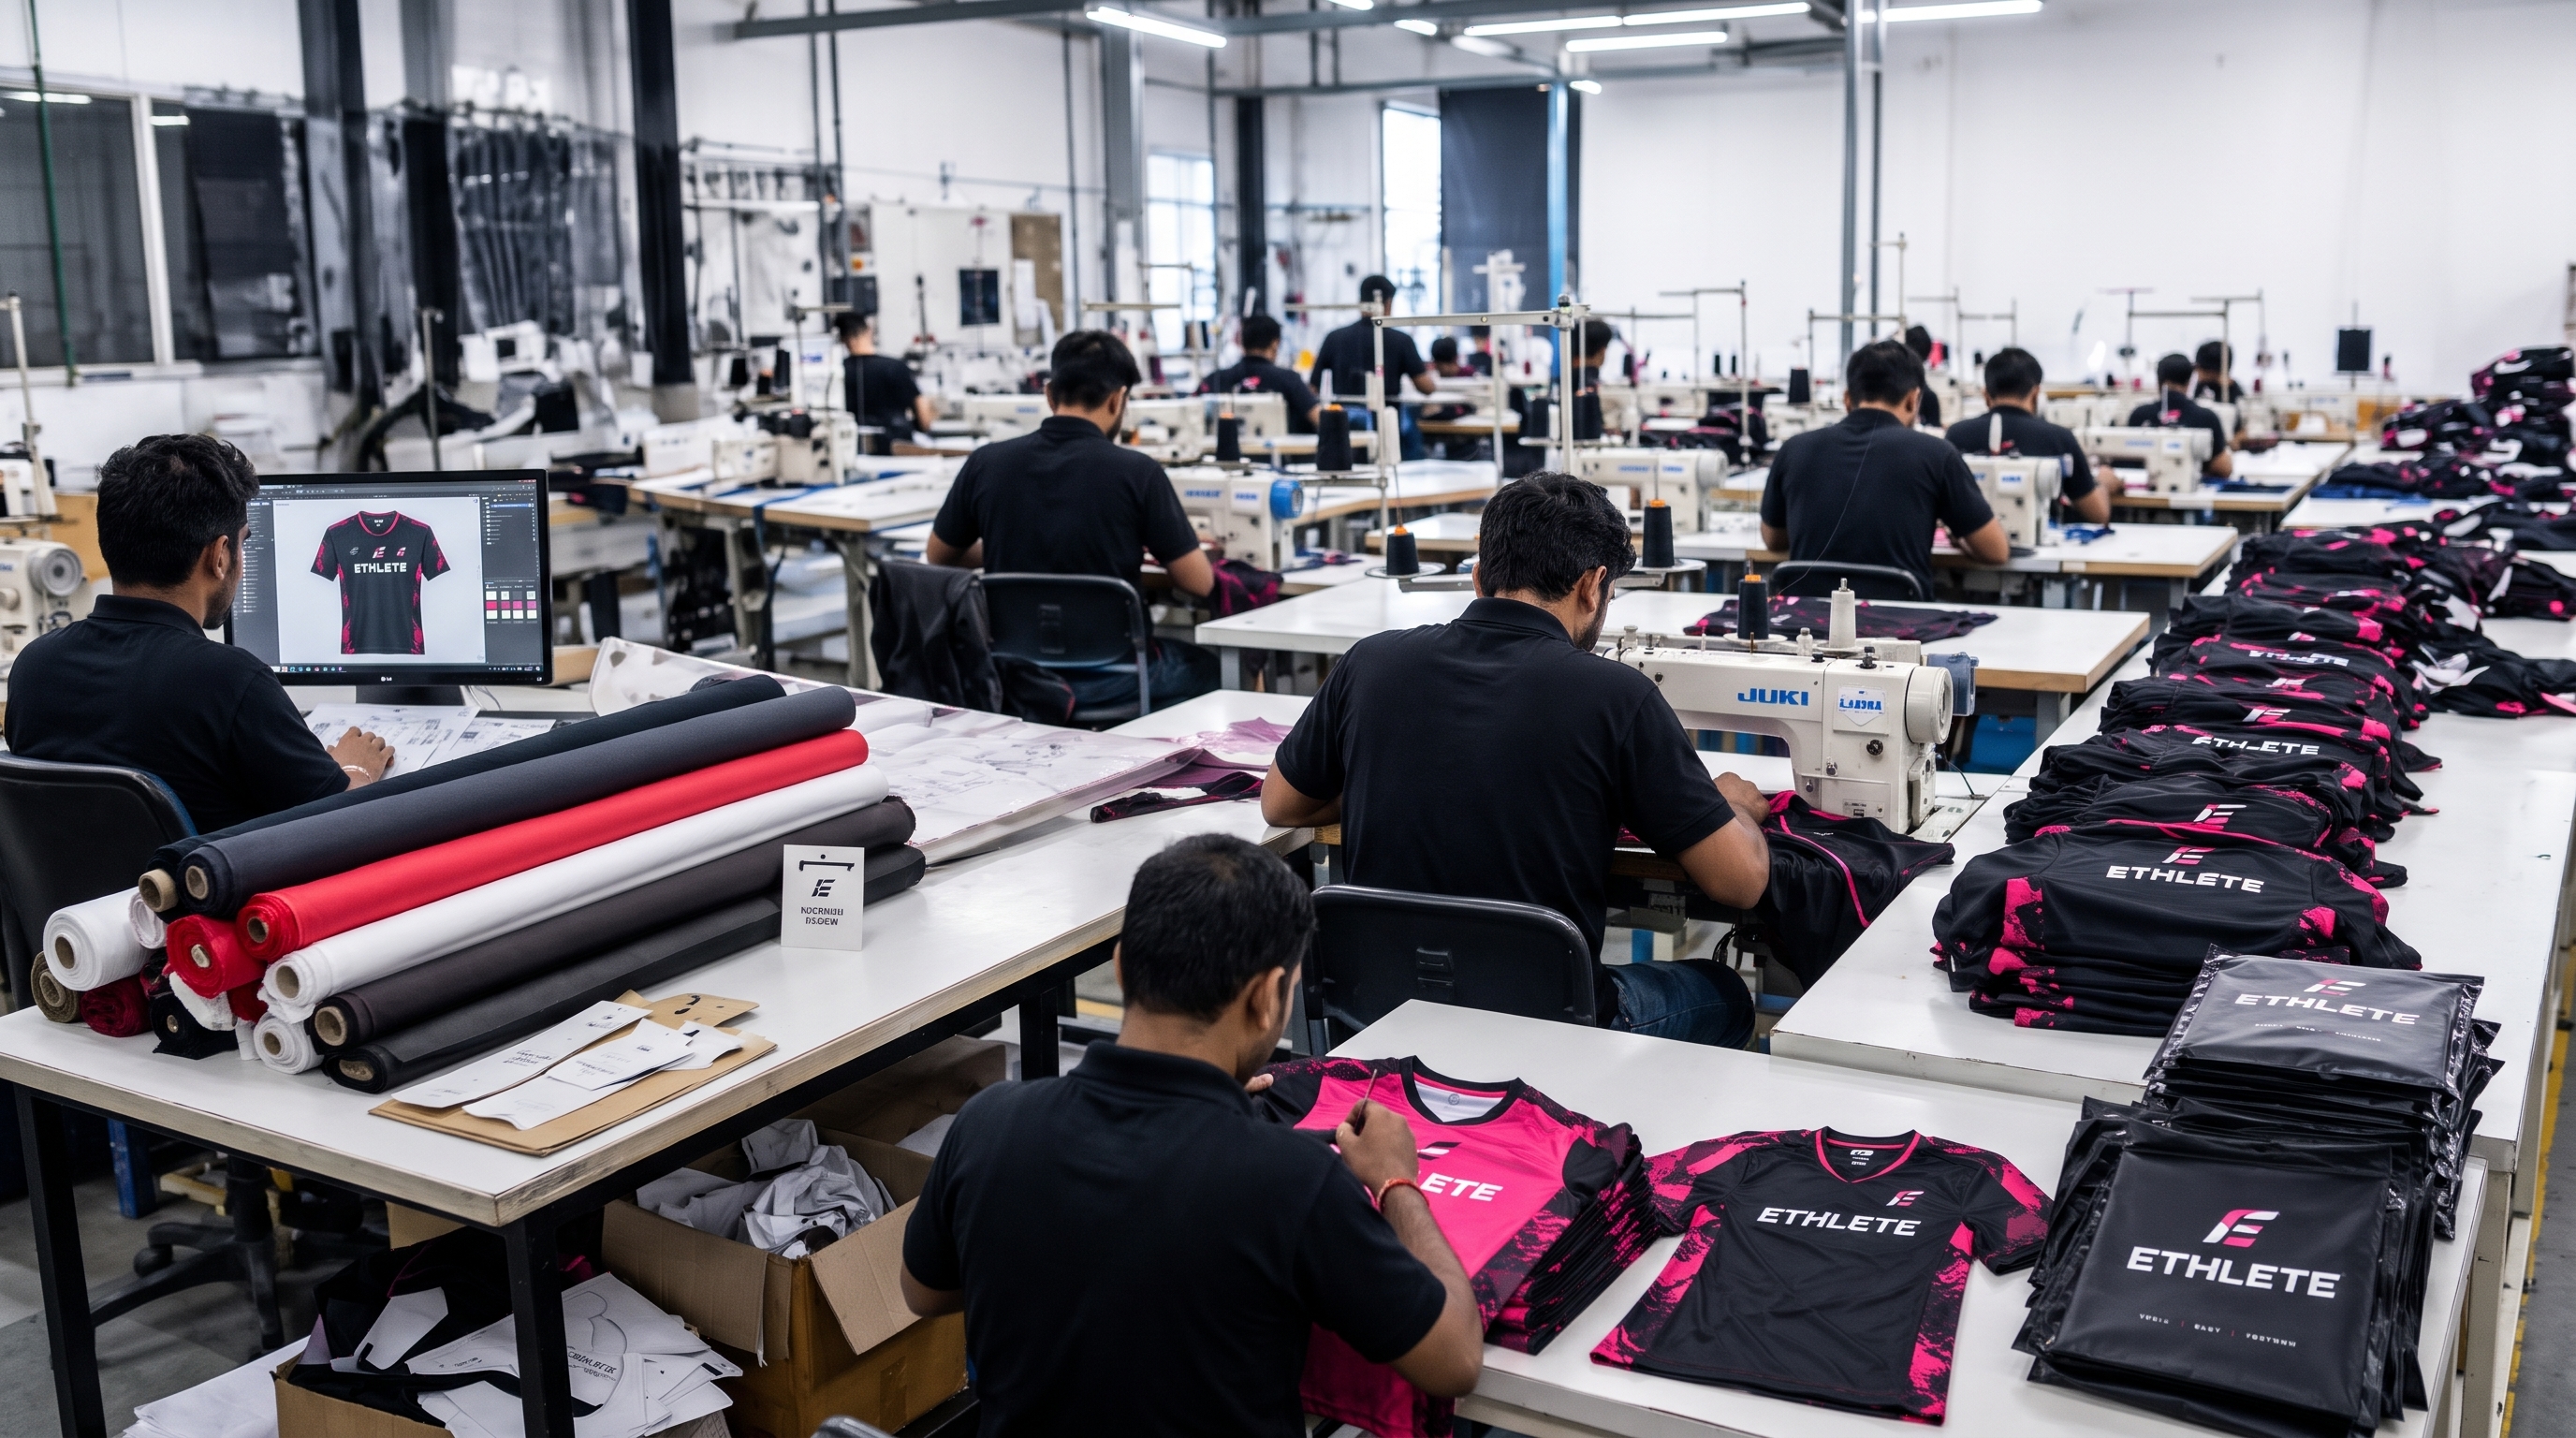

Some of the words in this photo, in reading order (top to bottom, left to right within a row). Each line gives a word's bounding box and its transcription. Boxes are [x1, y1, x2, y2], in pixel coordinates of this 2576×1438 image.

[354, 562, 407, 574] ETHLETE
[1737, 687, 1809, 707] JUKI
[2105, 865, 2265, 893] ETHLETE
[2234, 993, 2421, 1025] ETHLETE
[1756, 1207, 1922, 1237] ETHLETE
[2126, 1245, 2341, 1299] ETHLETE
